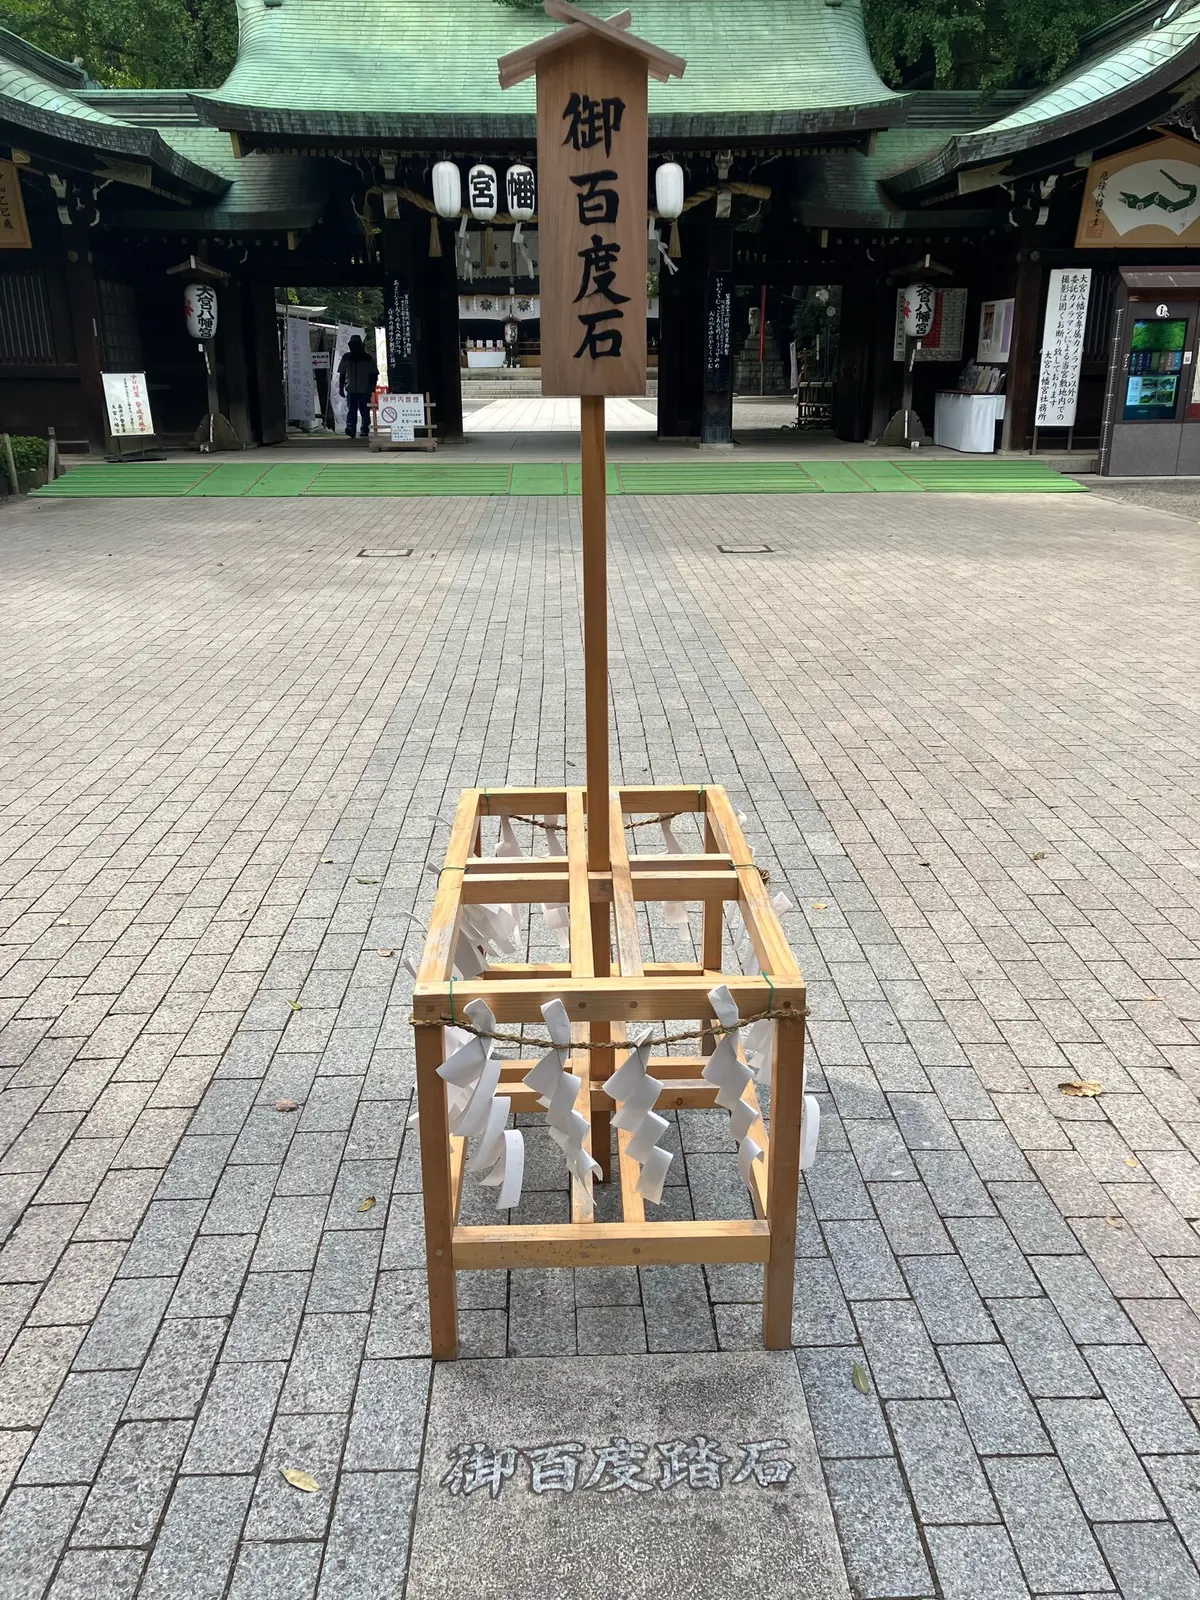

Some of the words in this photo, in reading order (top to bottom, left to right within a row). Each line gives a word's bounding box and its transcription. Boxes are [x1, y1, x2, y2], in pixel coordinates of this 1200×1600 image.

[471, 170, 495, 208] 宮
[508, 171, 535, 209] 幡
[562, 93, 631, 360] 御百度石
[196, 285, 215, 338] 大宮八幡宮
[916, 283, 932, 335] 大宮八幡宮
[1049, 274, 1070, 408] 撮影は固くお断り致しております
[1067, 274, 1088, 405] 大宮八幡宮専属カメラマン以外の
[1056, 274, 1079, 420] 委託カメラマンによる当宮敷地内での
[1037, 350, 1053, 421] 大宮八幡宮社務所
[440, 1435, 796, 1499] 御百度踏石
